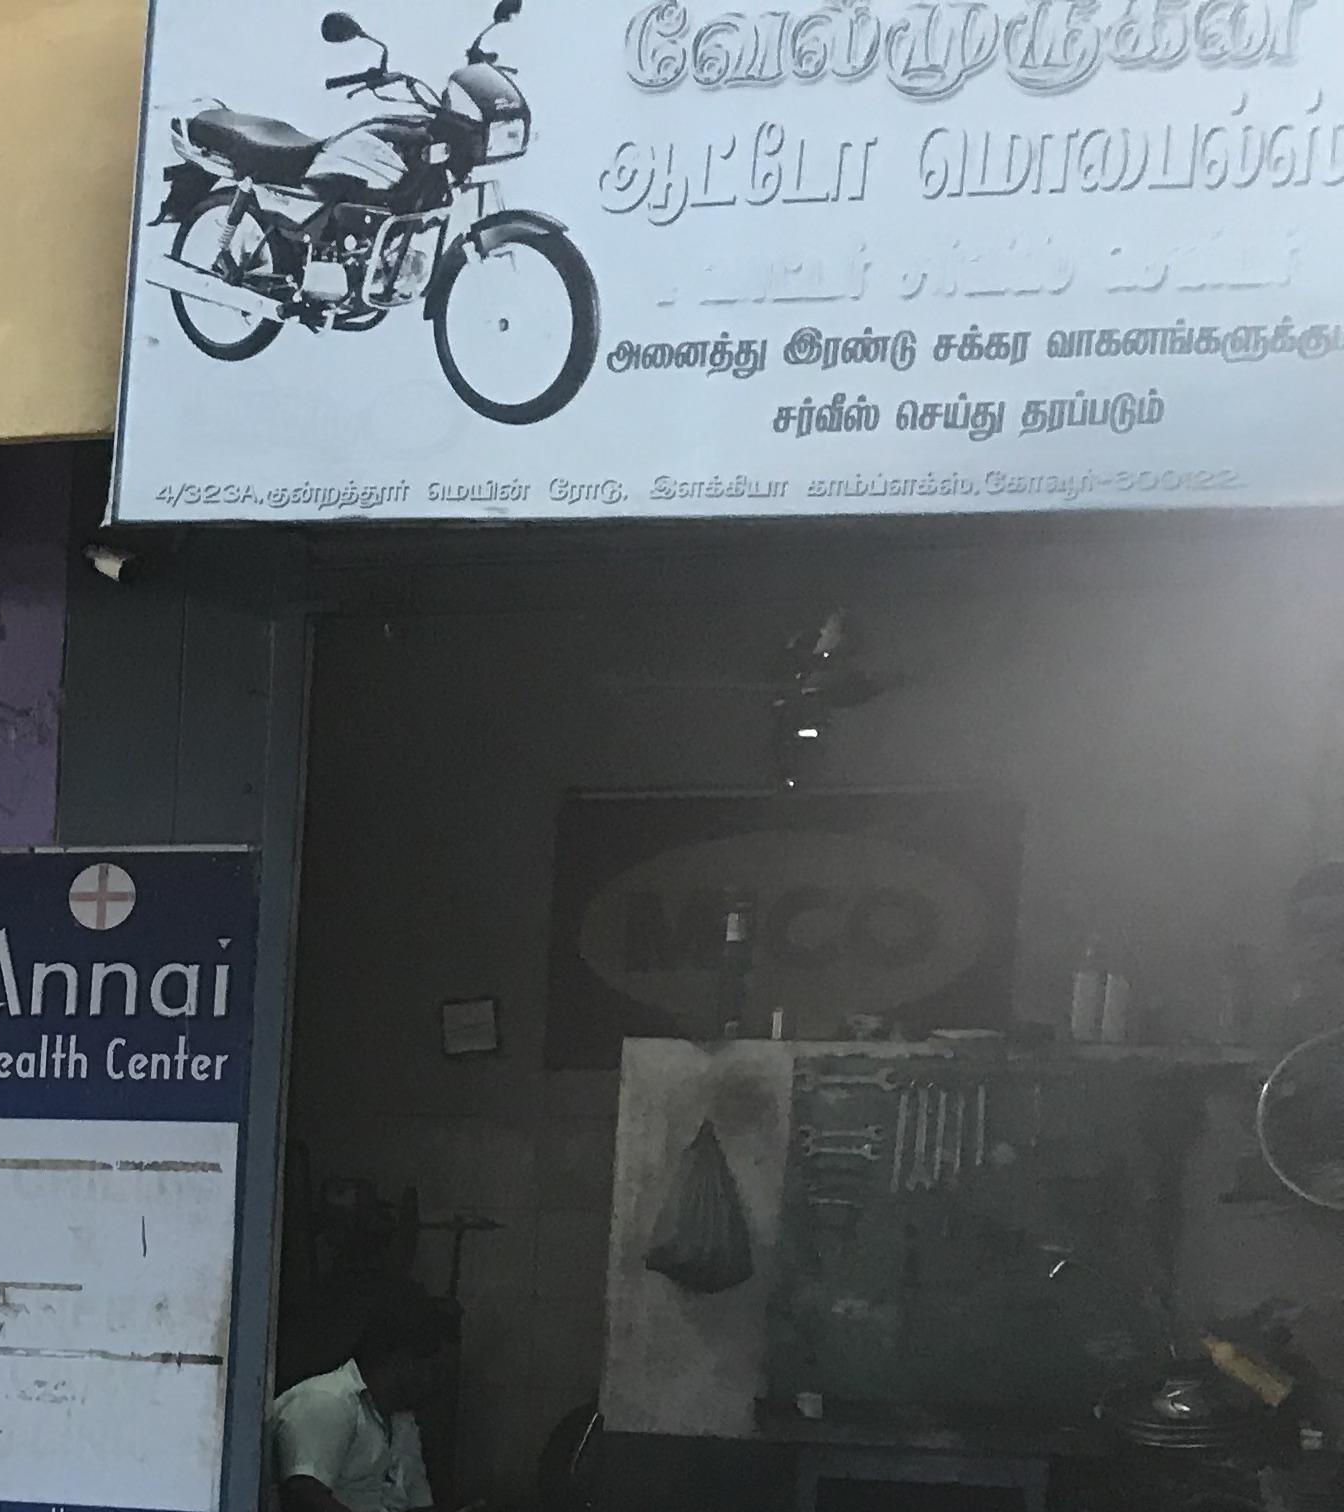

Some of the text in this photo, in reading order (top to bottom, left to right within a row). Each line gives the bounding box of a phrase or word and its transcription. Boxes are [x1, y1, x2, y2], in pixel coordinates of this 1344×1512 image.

[599, 121, 879, 226] ஆட்டோ
[606, 330, 768, 379] அனைத்து
[783, 326, 917, 371] இரண்டு
[932, 323, 1032, 367] சக்கர
[772, 387, 1165, 442] சர்வீஸ் செய்து தரப்படும்
[106, 1035, 230, 1081] Center
